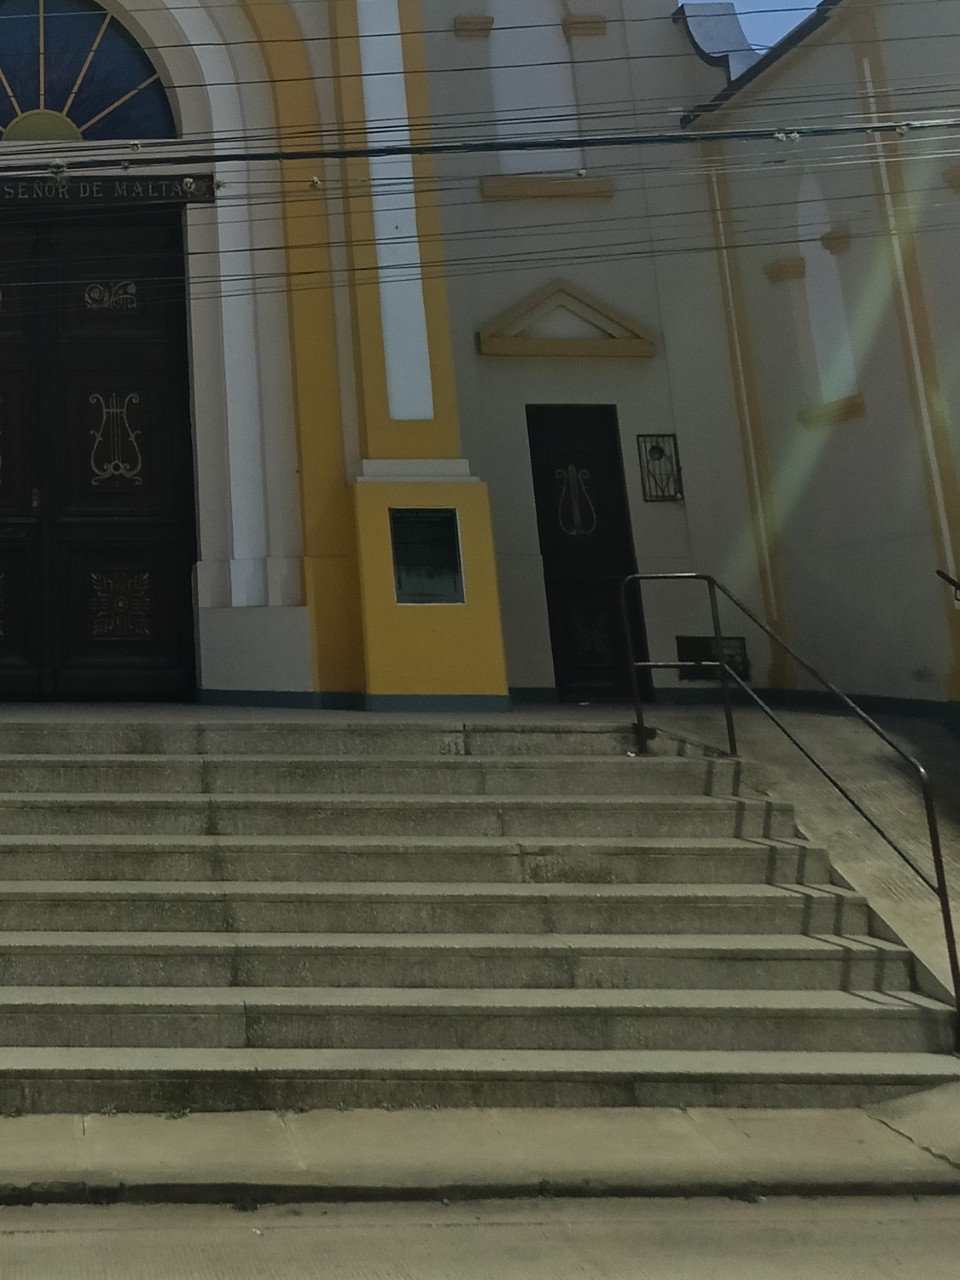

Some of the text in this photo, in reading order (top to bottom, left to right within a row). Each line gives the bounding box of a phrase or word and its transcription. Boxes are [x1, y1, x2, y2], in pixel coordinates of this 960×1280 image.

[3, 179, 69, 199] SEÑOR
[80, 181, 104, 198] DE
[115, 181, 183, 197] MALTA
